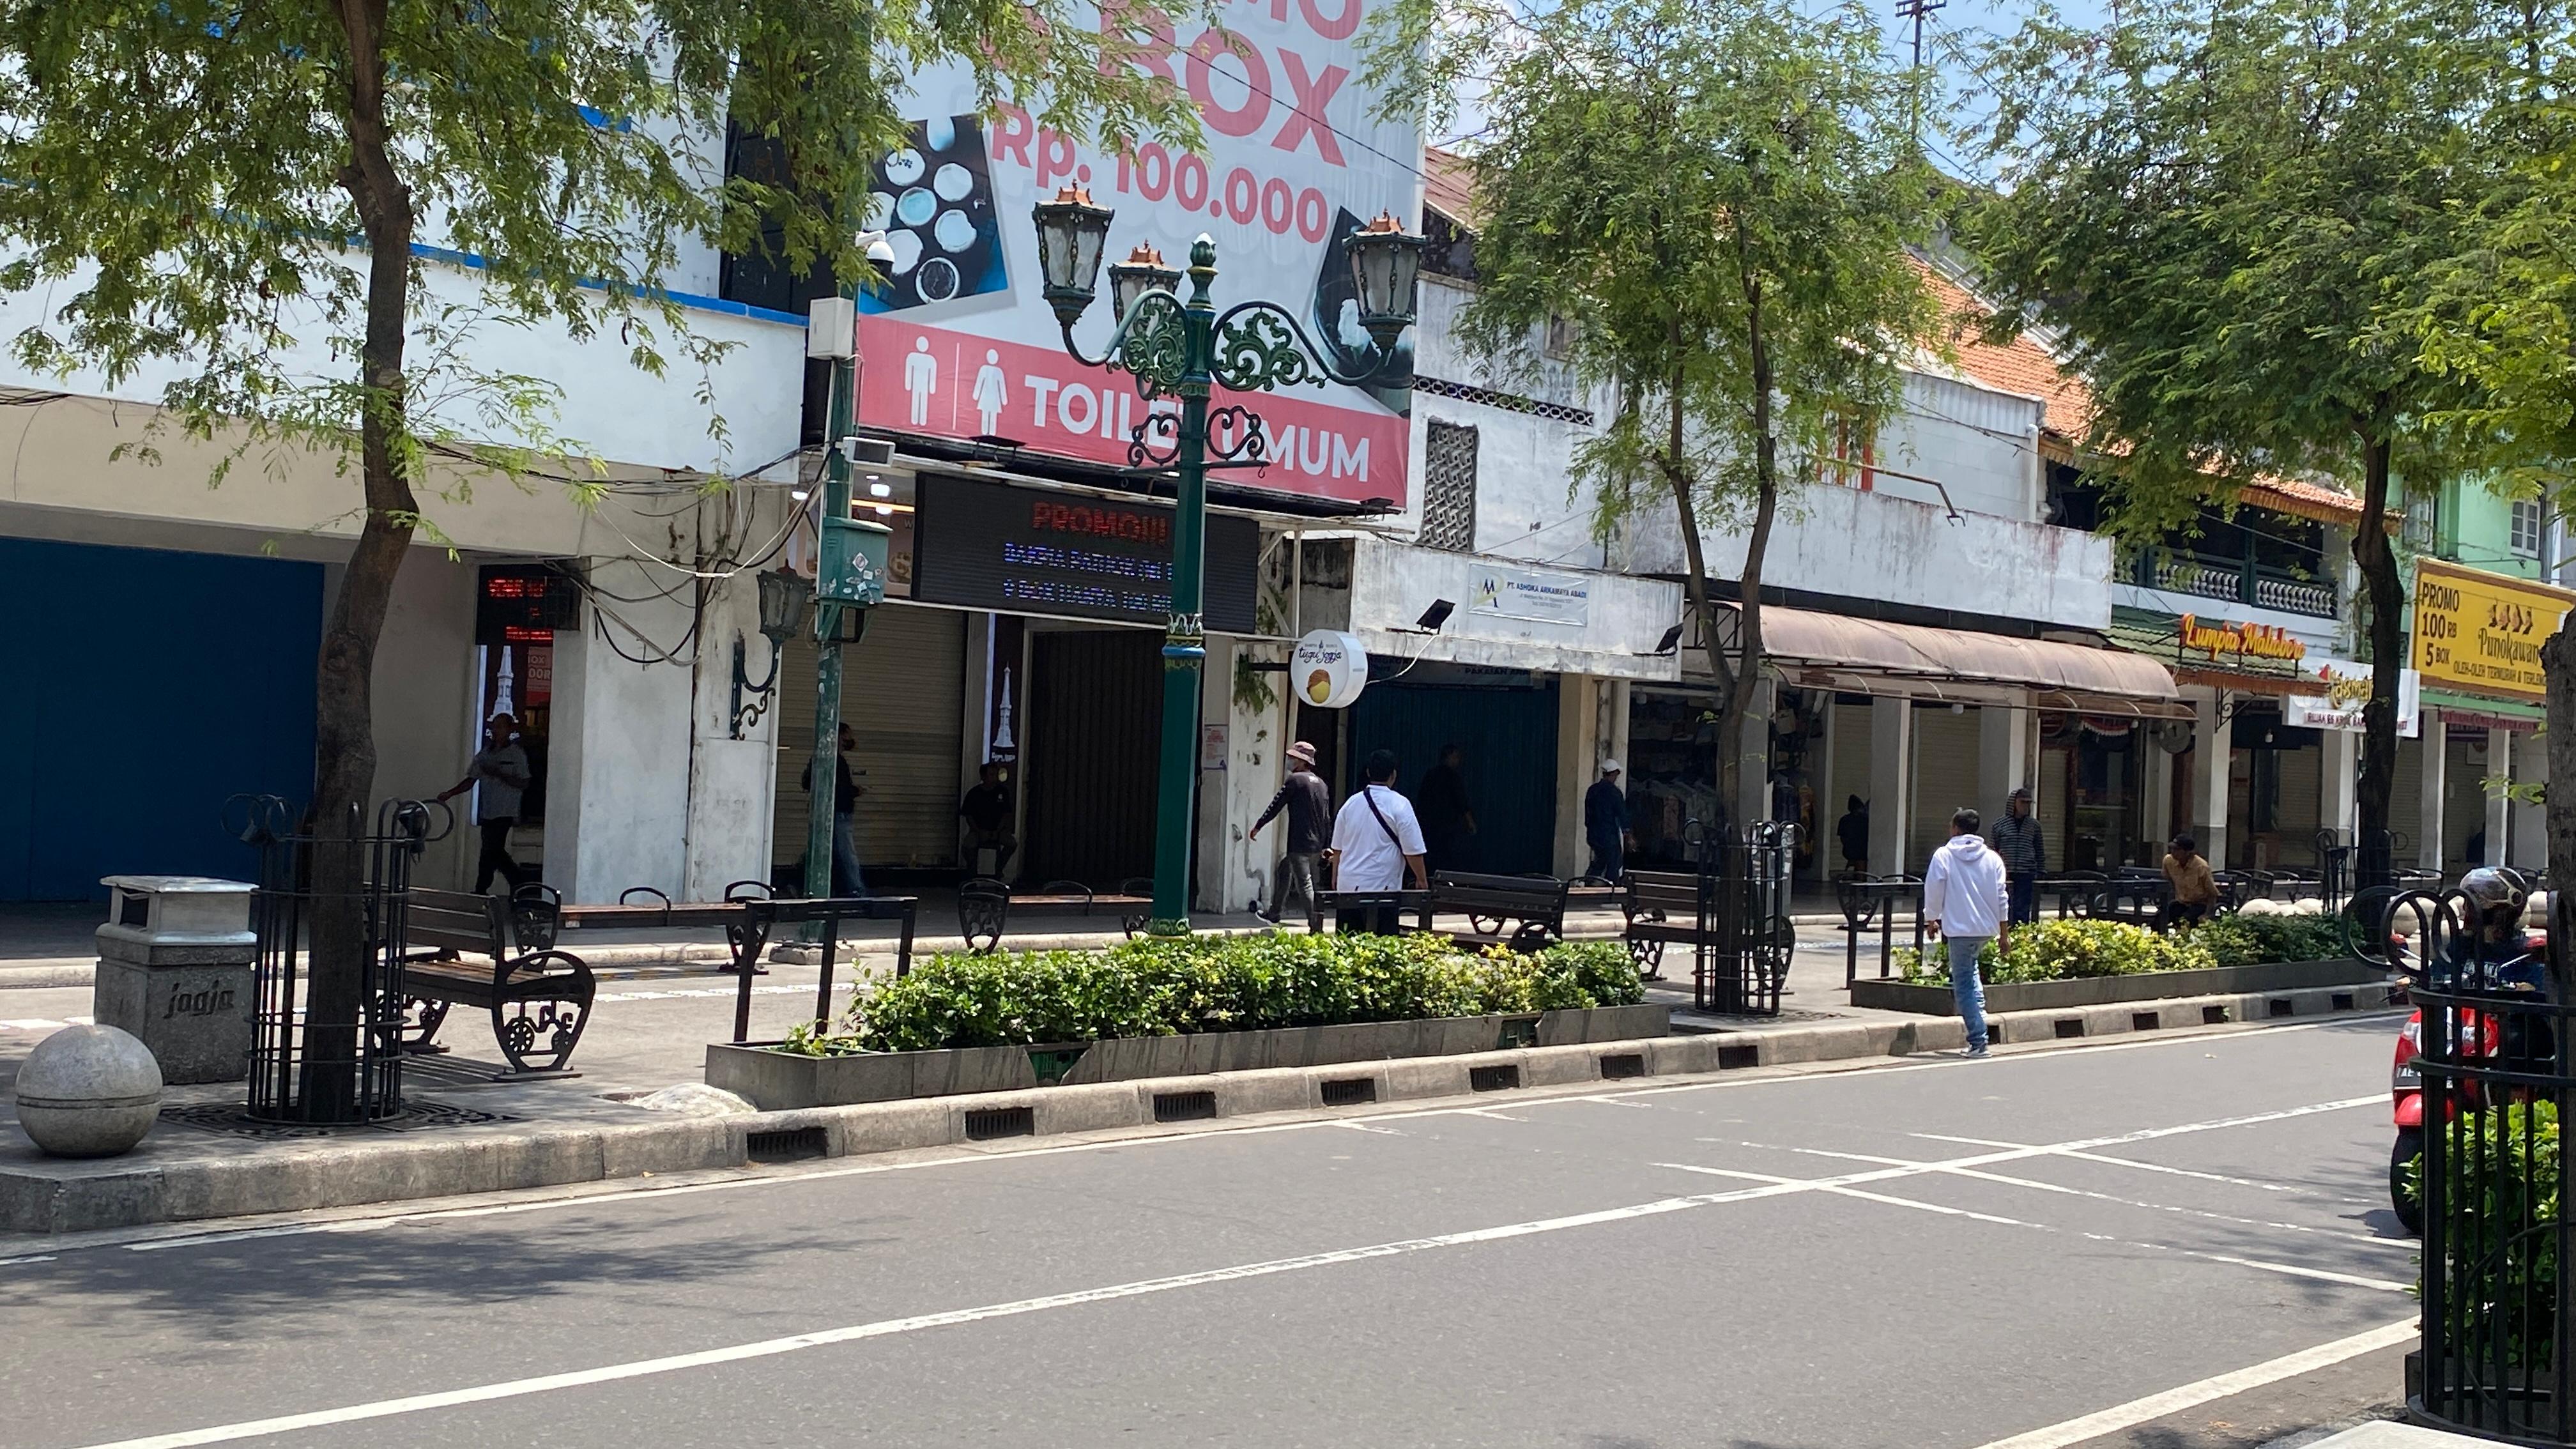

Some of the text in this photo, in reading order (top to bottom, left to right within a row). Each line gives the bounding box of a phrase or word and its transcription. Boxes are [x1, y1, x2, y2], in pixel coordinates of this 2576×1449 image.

[992, 99, 1328, 243] Rp. 100.000
[1024, 374, 1370, 483] TOILE UMUM
[2421, 582, 2460, 613] PROMO
[2182, 613, 2241, 661] Lumpia
[2422, 611, 2457, 640] 100 RB
[2425, 642, 2451, 667] 5 BOX
